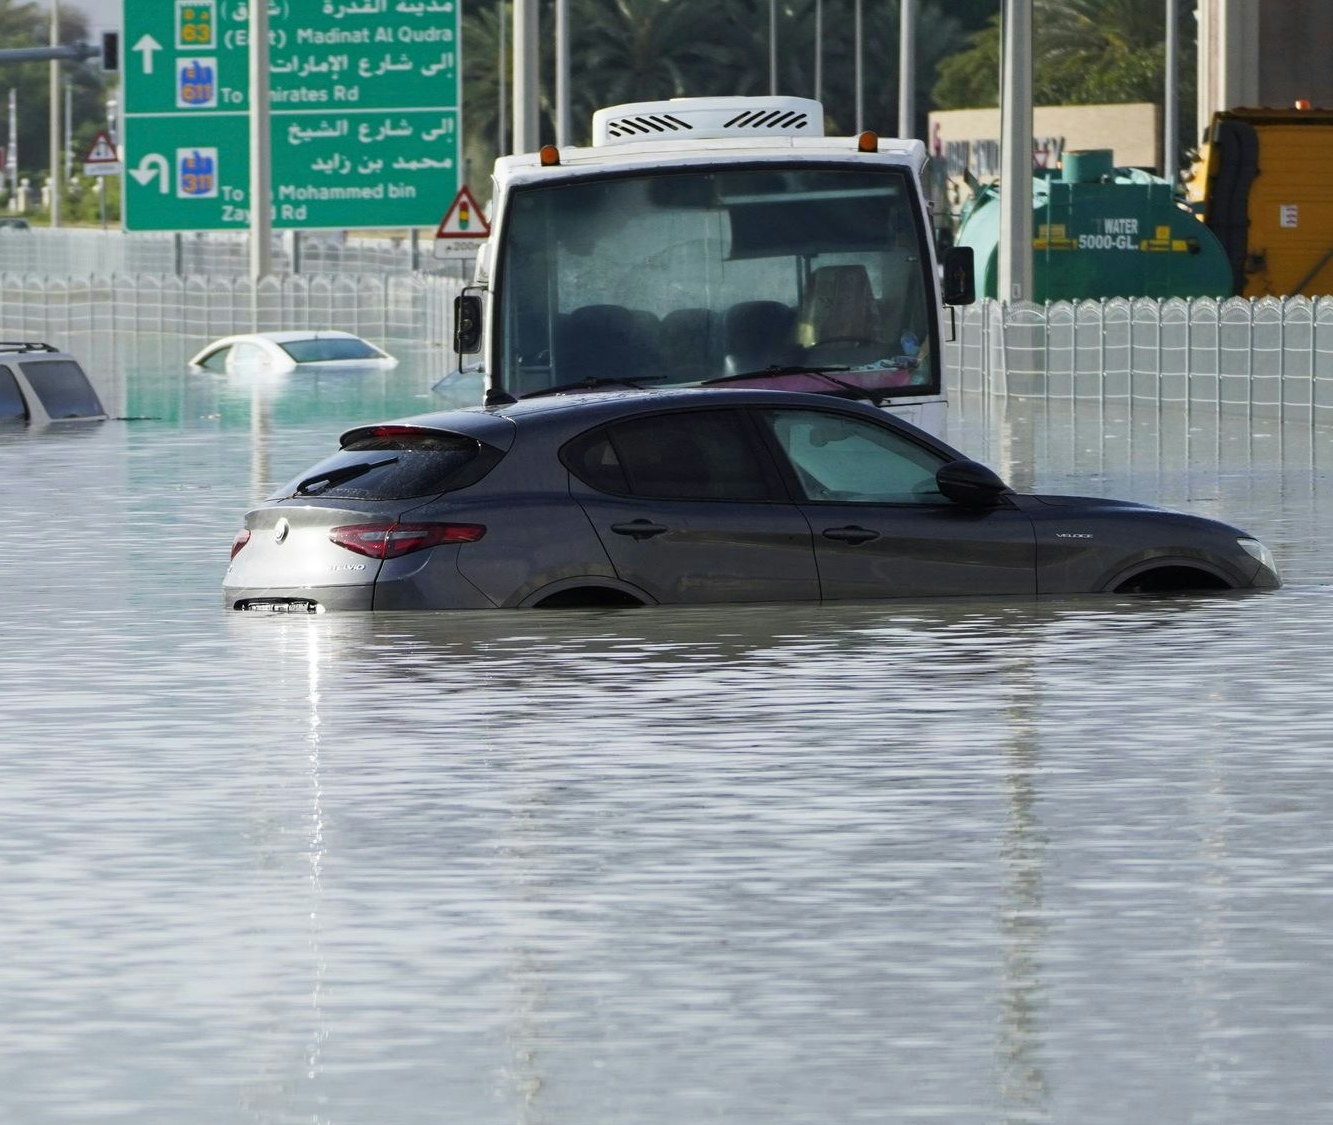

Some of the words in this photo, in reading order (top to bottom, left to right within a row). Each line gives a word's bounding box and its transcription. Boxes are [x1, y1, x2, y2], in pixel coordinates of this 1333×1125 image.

[181, 23, 211, 42] 63
[223, 28, 287, 49] (Et)
[297, 27, 370, 45] Madinat
[374, 26, 394, 43] Al
[397, 25, 454, 44] Qudra
[357, 53, 414, 77] شارع
[420, 52, 454, 79] إلى
[181, 83, 213, 101] 611
[221, 87, 244, 104] To
[268, 85, 328, 103] mirates
[333, 85, 360, 102] Rd
[287, 119, 349, 145] الشيخ
[357, 118, 414, 143] شارع
[420, 117, 454, 143] إلى
[311, 152, 352, 175] زايد
[357, 155, 384, 174] بن
[391, 155, 454, 171] محمد
[181, 174, 213, 194] 311
[221, 185, 244, 202] To
[278, 184, 385, 201] Mohammed
[388, 182, 417, 199] bin
[280, 204, 307, 221] Rd
[1104, 218, 1139, 234] WATER
[1078, 234, 1139, 250] 5000-GL.
